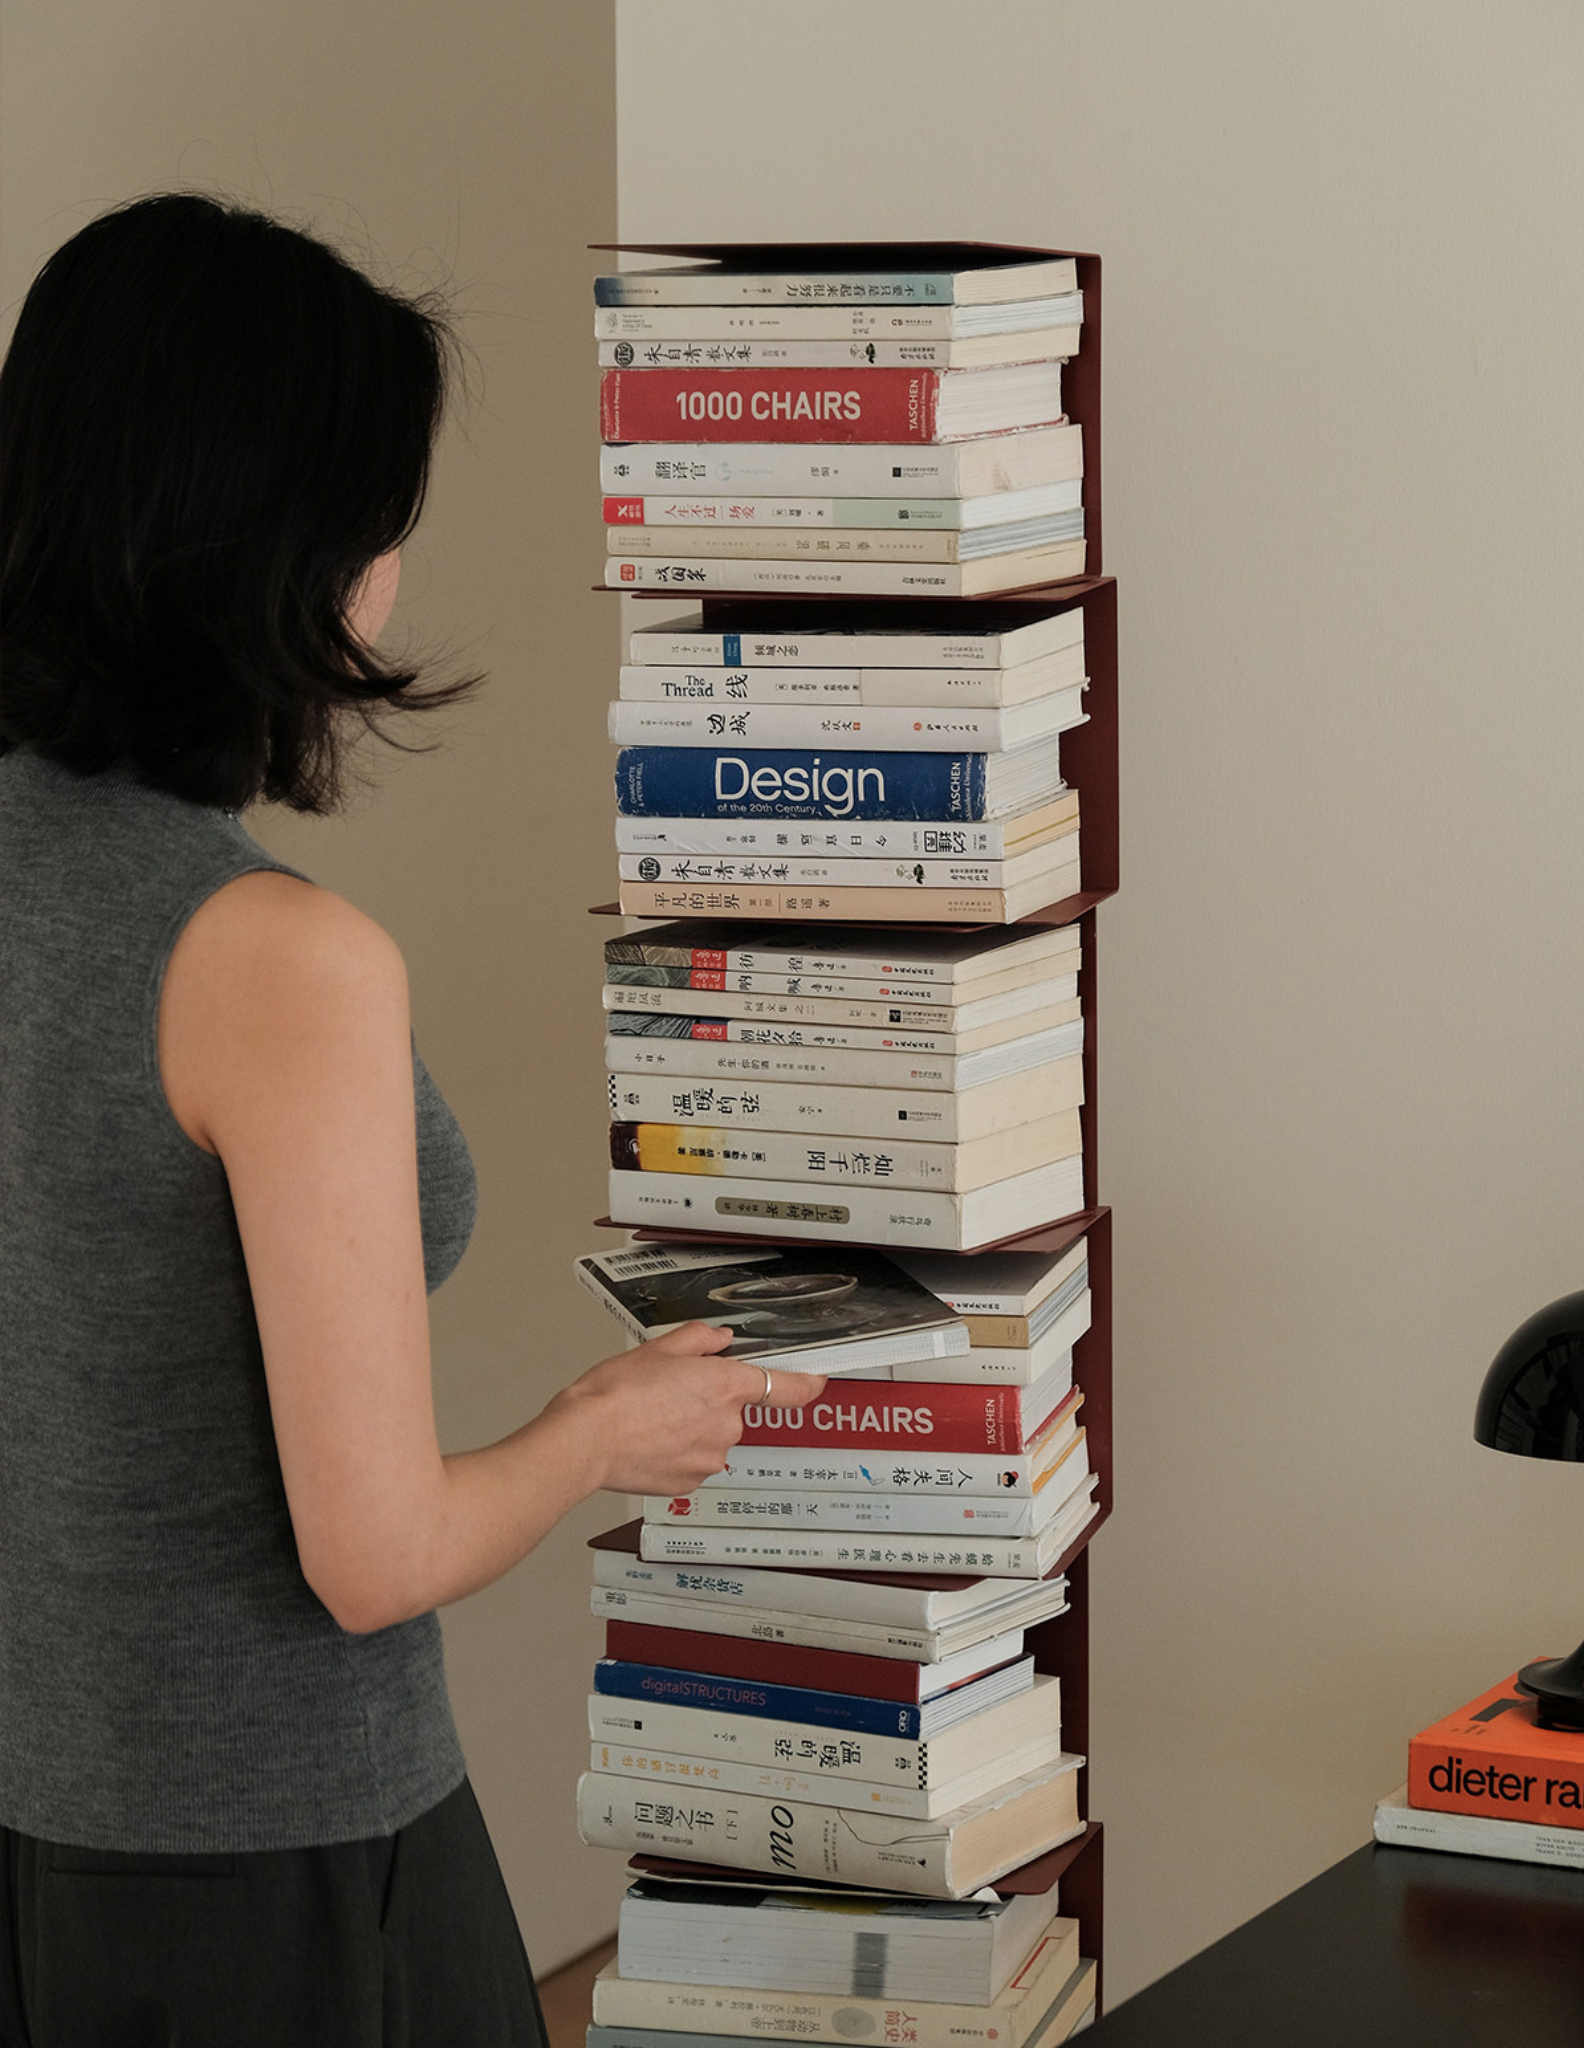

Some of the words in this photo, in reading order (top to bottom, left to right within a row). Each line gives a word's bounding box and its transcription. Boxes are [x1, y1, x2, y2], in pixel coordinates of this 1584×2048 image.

[786, 283, 916, 298] 不要只是看起来很努力
[643, 343, 751, 364] 朱自清散文集
[676, 391, 743, 421] 1000
[751, 391, 861, 421] CHAIRS
[908, 379, 919, 431] TASCHEN
[655, 461, 707, 480] 翻译官
[664, 504, 756, 519] 人生不过一场爱
[655, 565, 708, 582] 战国策
[754, 644, 799, 657] 倾城之恋
[661, 682, 714, 697] Thread
[685, 674, 706, 687] The
[725, 674, 749, 698] 线
[707, 711, 750, 737] 边城
[821, 719, 852, 731] 沈从文
[715, 757, 886, 815] Design
[950, 762, 962, 812] TASCHEN
[717, 804, 728, 812] of
[730, 804, 747, 812] the
[749, 804, 773, 813] 20th
[775, 804, 817, 816] Century
[776, 833, 887, 846] 今日宜远游
[924, 830, 967, 853] 幼稚园
[671, 859, 790, 881] 朱自清散文集
[655, 892, 741, 910] 平凡的世界
[749, 898, 773, 907] 第一部
[786, 898, 813, 909] 路遥
[818, 898, 830, 908] 著
[739, 953, 803, 973] 彷徨
[737, 975, 802, 994] 呐喊
[613, 991, 661, 1006] 遍地风流
[743, 1001, 788, 1014] 阿城文集
[740, 1029, 803, 1047] 朝花夕拾
[635, 1053, 666, 1064] 小日子
[673, 1087, 761, 1117] 温暖的弦
[807, 1150, 894, 1176] 灿烂千阳
[765, 1203, 779, 1217] 著
[787, 1204, 843, 1223] 村上春树
[889, 1214, 932, 1226] 奇鸟行状录
[744, 1404, 803, 1430] 000
[813, 1404, 934, 1434] CHAIRS
[985, 1398, 996, 1446] TASCHEN
[789, 1470, 798, 1478] 著
[804, 1468, 838, 1480] 太宰治
[892, 1467, 973, 1488] 人间失格
[717, 1501, 819, 1517] 时间停止的那一天
[837, 1548, 994, 1567] 蛤蟆先生去看心理医生
[675, 1572, 744, 1597] 解忧杂货店
[641, 1677, 767, 1707] digitalSTRUCTURES
[774, 1738, 862, 1769] 温暖的弦
[621, 1754, 720, 1780] 你的感冒很梵高
[1428, 1756, 1537, 1803] dieter
[1545, 1778, 1584, 1810] ra
[635, 1802, 715, 1832] 问题之书
[750, 2016, 822, 2034] 从动物到上帝
[883, 2010, 900, 2043] 简史
[902, 2010, 918, 2043] 人类
